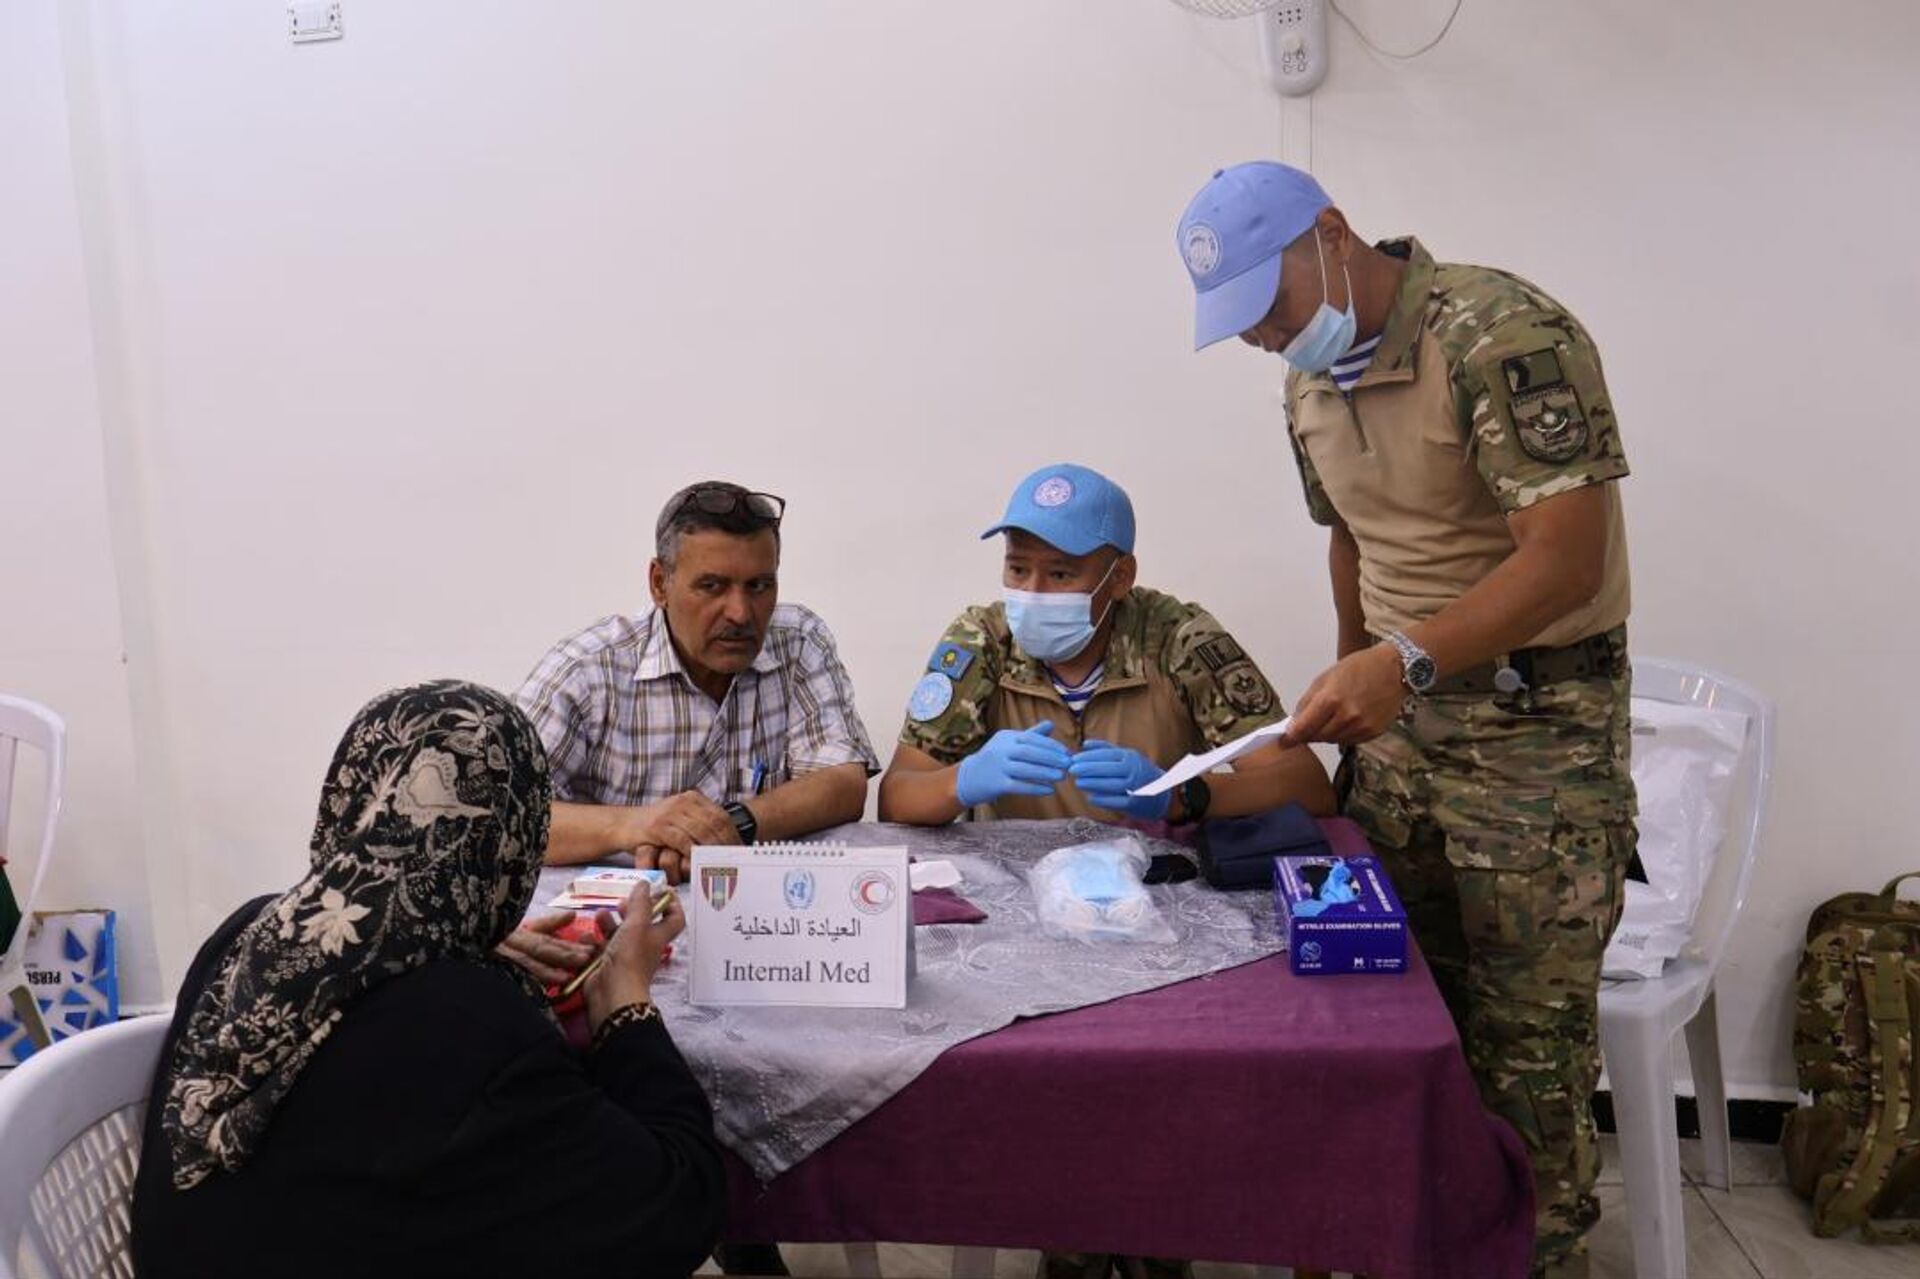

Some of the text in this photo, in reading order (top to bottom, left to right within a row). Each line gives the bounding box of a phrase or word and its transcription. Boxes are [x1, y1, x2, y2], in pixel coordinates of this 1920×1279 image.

[733, 915, 861, 942] العيادة الداخلية
[723, 959, 871, 983] Internal Med
